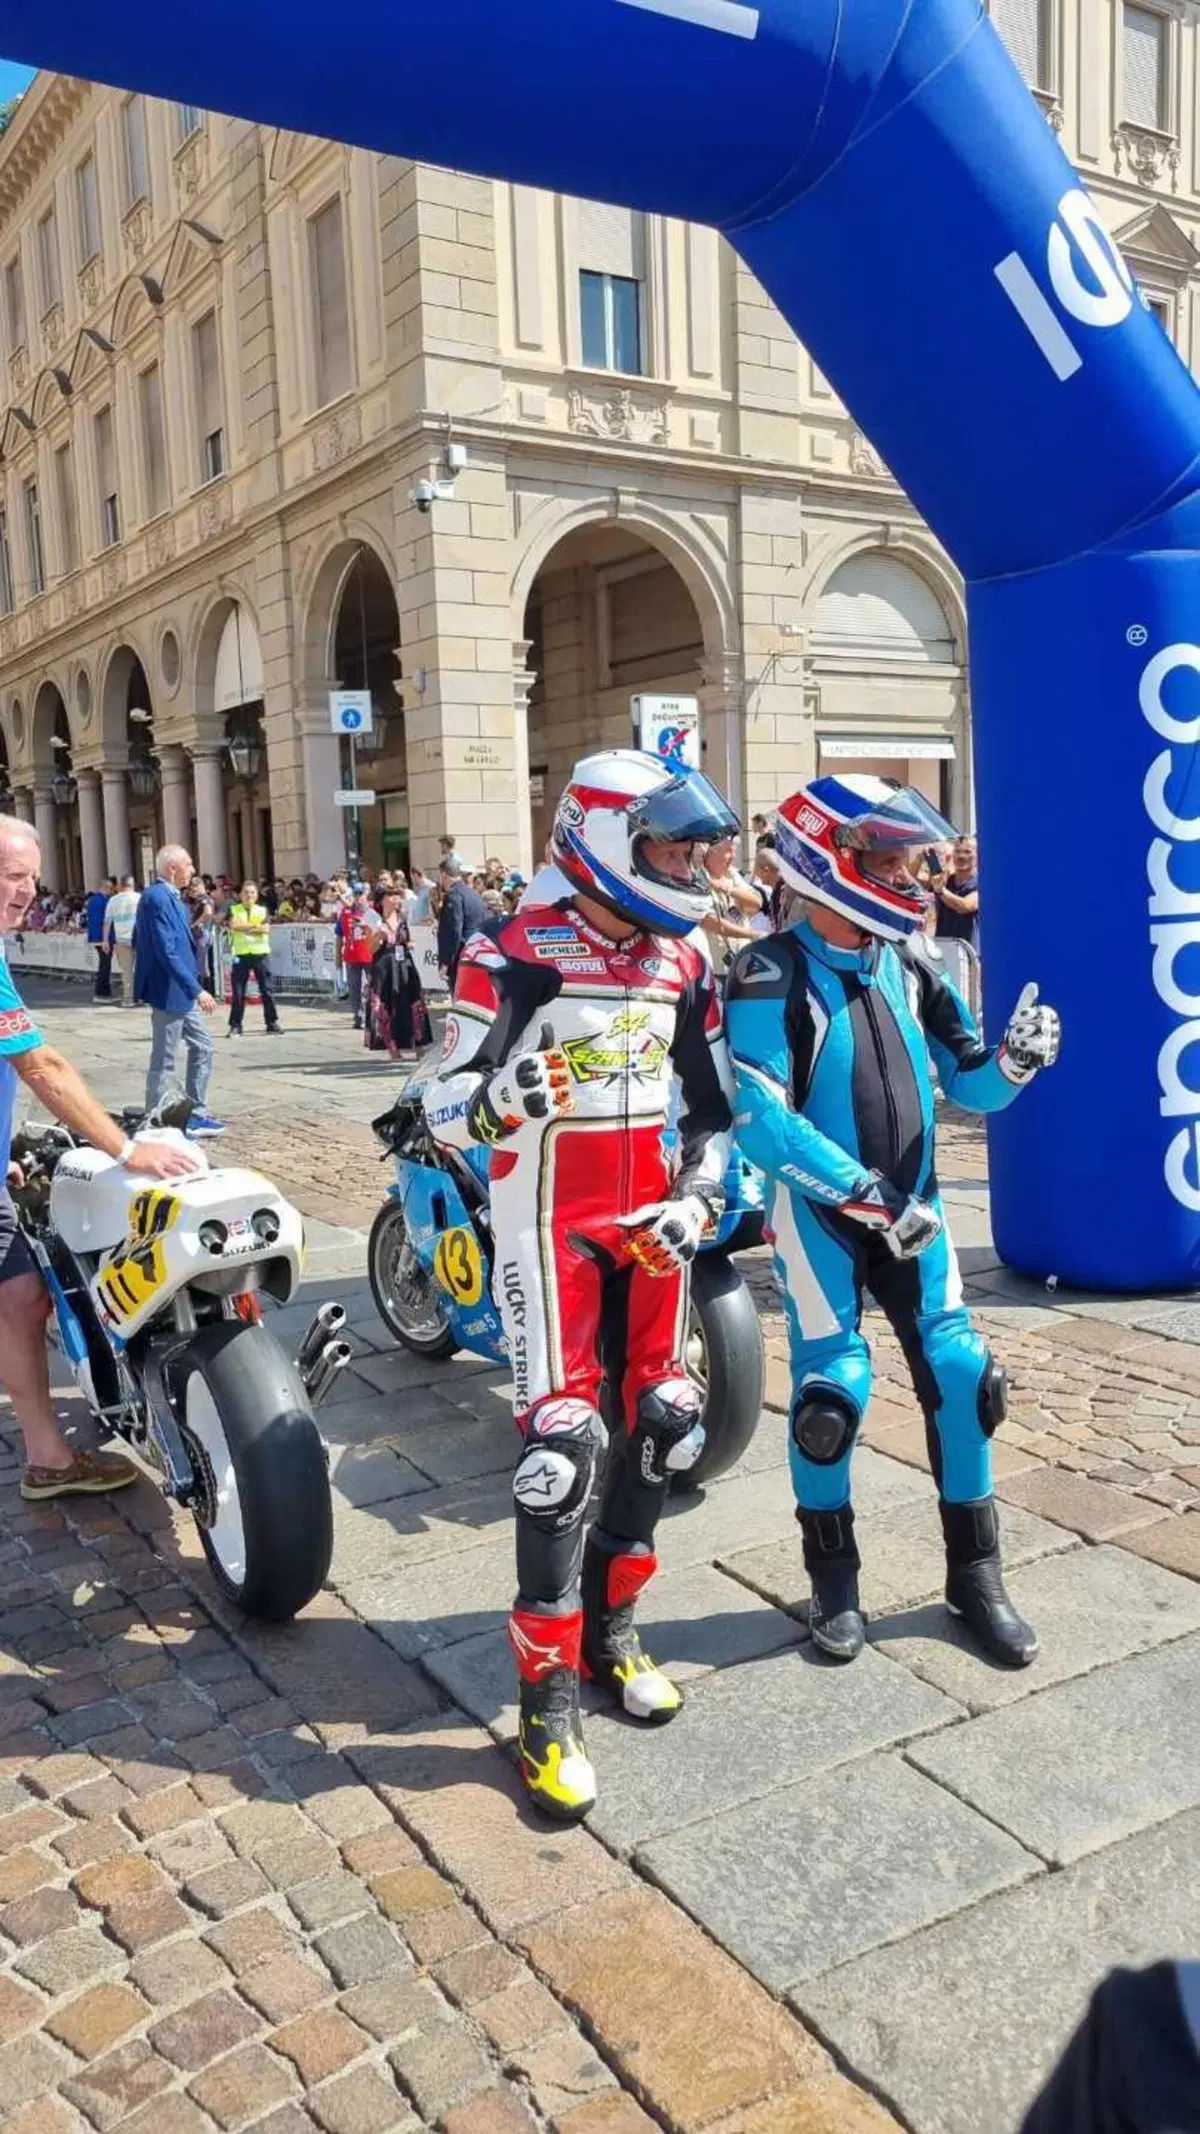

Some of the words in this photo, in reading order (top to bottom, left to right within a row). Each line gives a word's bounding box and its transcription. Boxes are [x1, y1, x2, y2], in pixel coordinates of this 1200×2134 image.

[538, 945, 588, 956] MICHELIN
[559, 960, 604, 972] MOTUL
[221, 1241, 271, 1258] SUZUKI
[502, 1261, 527, 1329] LUCKY
[515, 1337, 530, 1411] STRIKE
